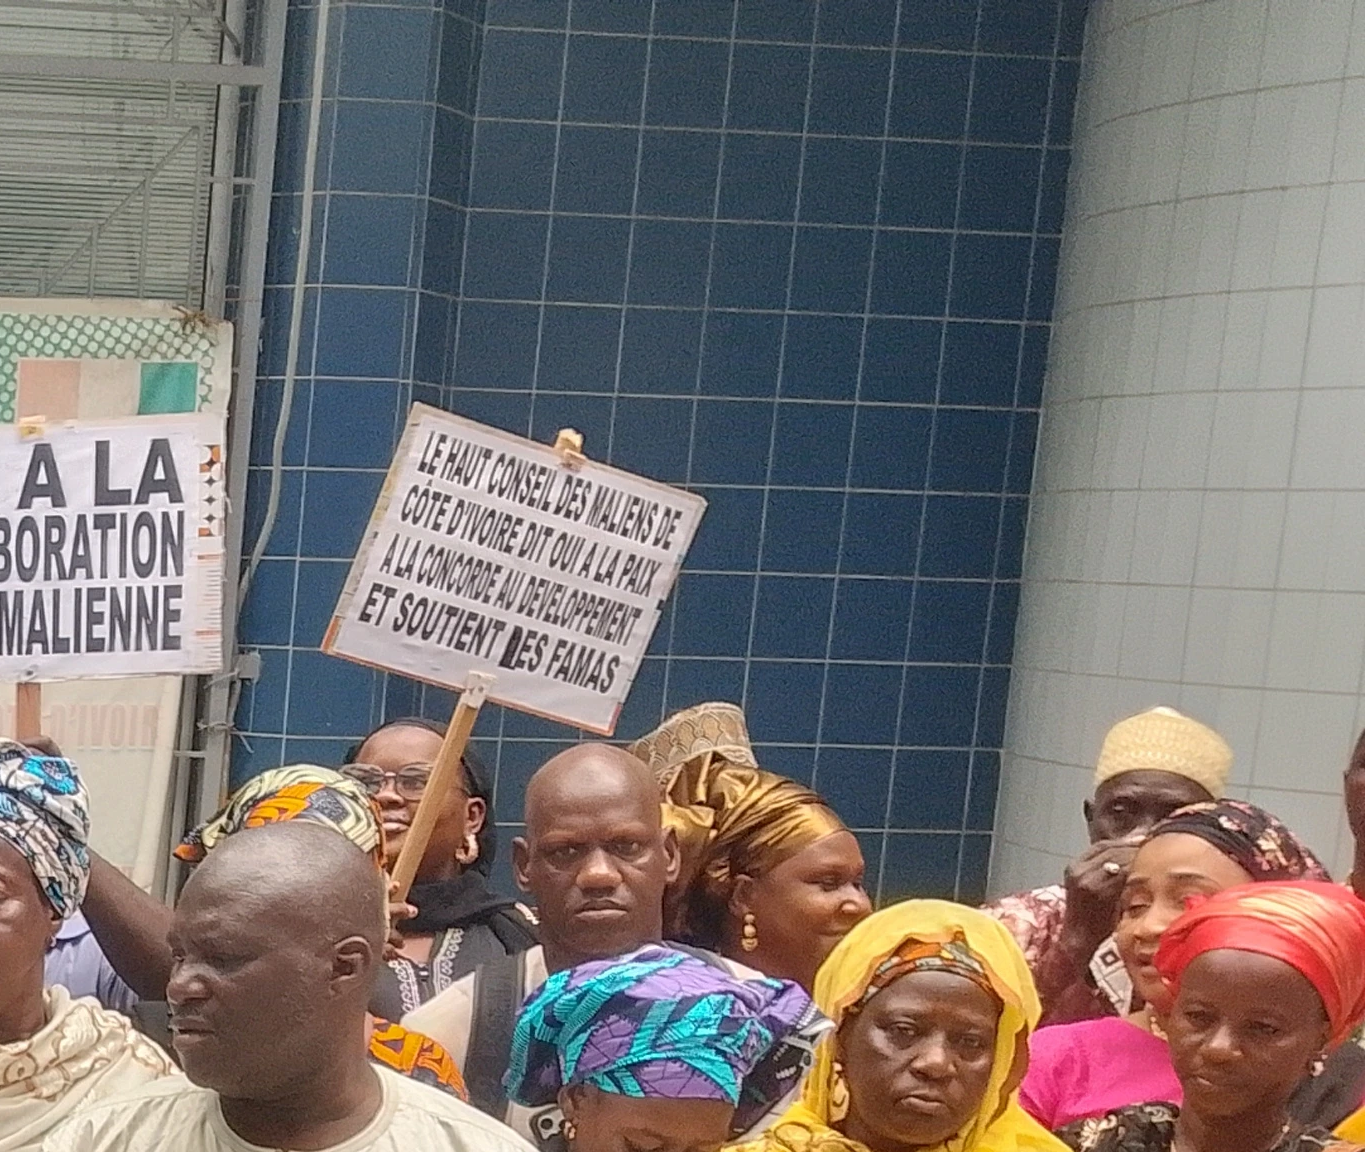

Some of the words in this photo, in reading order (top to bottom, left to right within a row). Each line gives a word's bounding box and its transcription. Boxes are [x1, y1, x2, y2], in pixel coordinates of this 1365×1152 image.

[17, 443, 66, 509] A
[94, 438, 184, 506] LA
[417, 431, 447, 475] LE
[439, 438, 493, 489] HAUT
[487, 452, 557, 511] CONSEIL
[552, 474, 591, 521] DES
[585, 485, 658, 543] MALIENS
[652, 506, 682, 550] DE
[379, 533, 399, 573] A
[393, 537, 421, 580] LA
[416, 544, 503, 603] CONCORDE
[493, 568, 525, 610] AU
[516, 575, 642, 645] DEVELOPPEMENT
[401, 479, 452, 531] CÔTE
[445, 498, 524, 554] D'IVOIRE
[517, 521, 554, 562] DIT
[548, 531, 585, 573] OUI
[577, 542, 598, 578] A
[593, 545, 621, 586] LA
[616, 553, 662, 597] PAIX
[357, 582, 397, 626] ET
[392, 592, 506, 658] SOUTIENT
[544, 638, 619, 693] FAMAS
